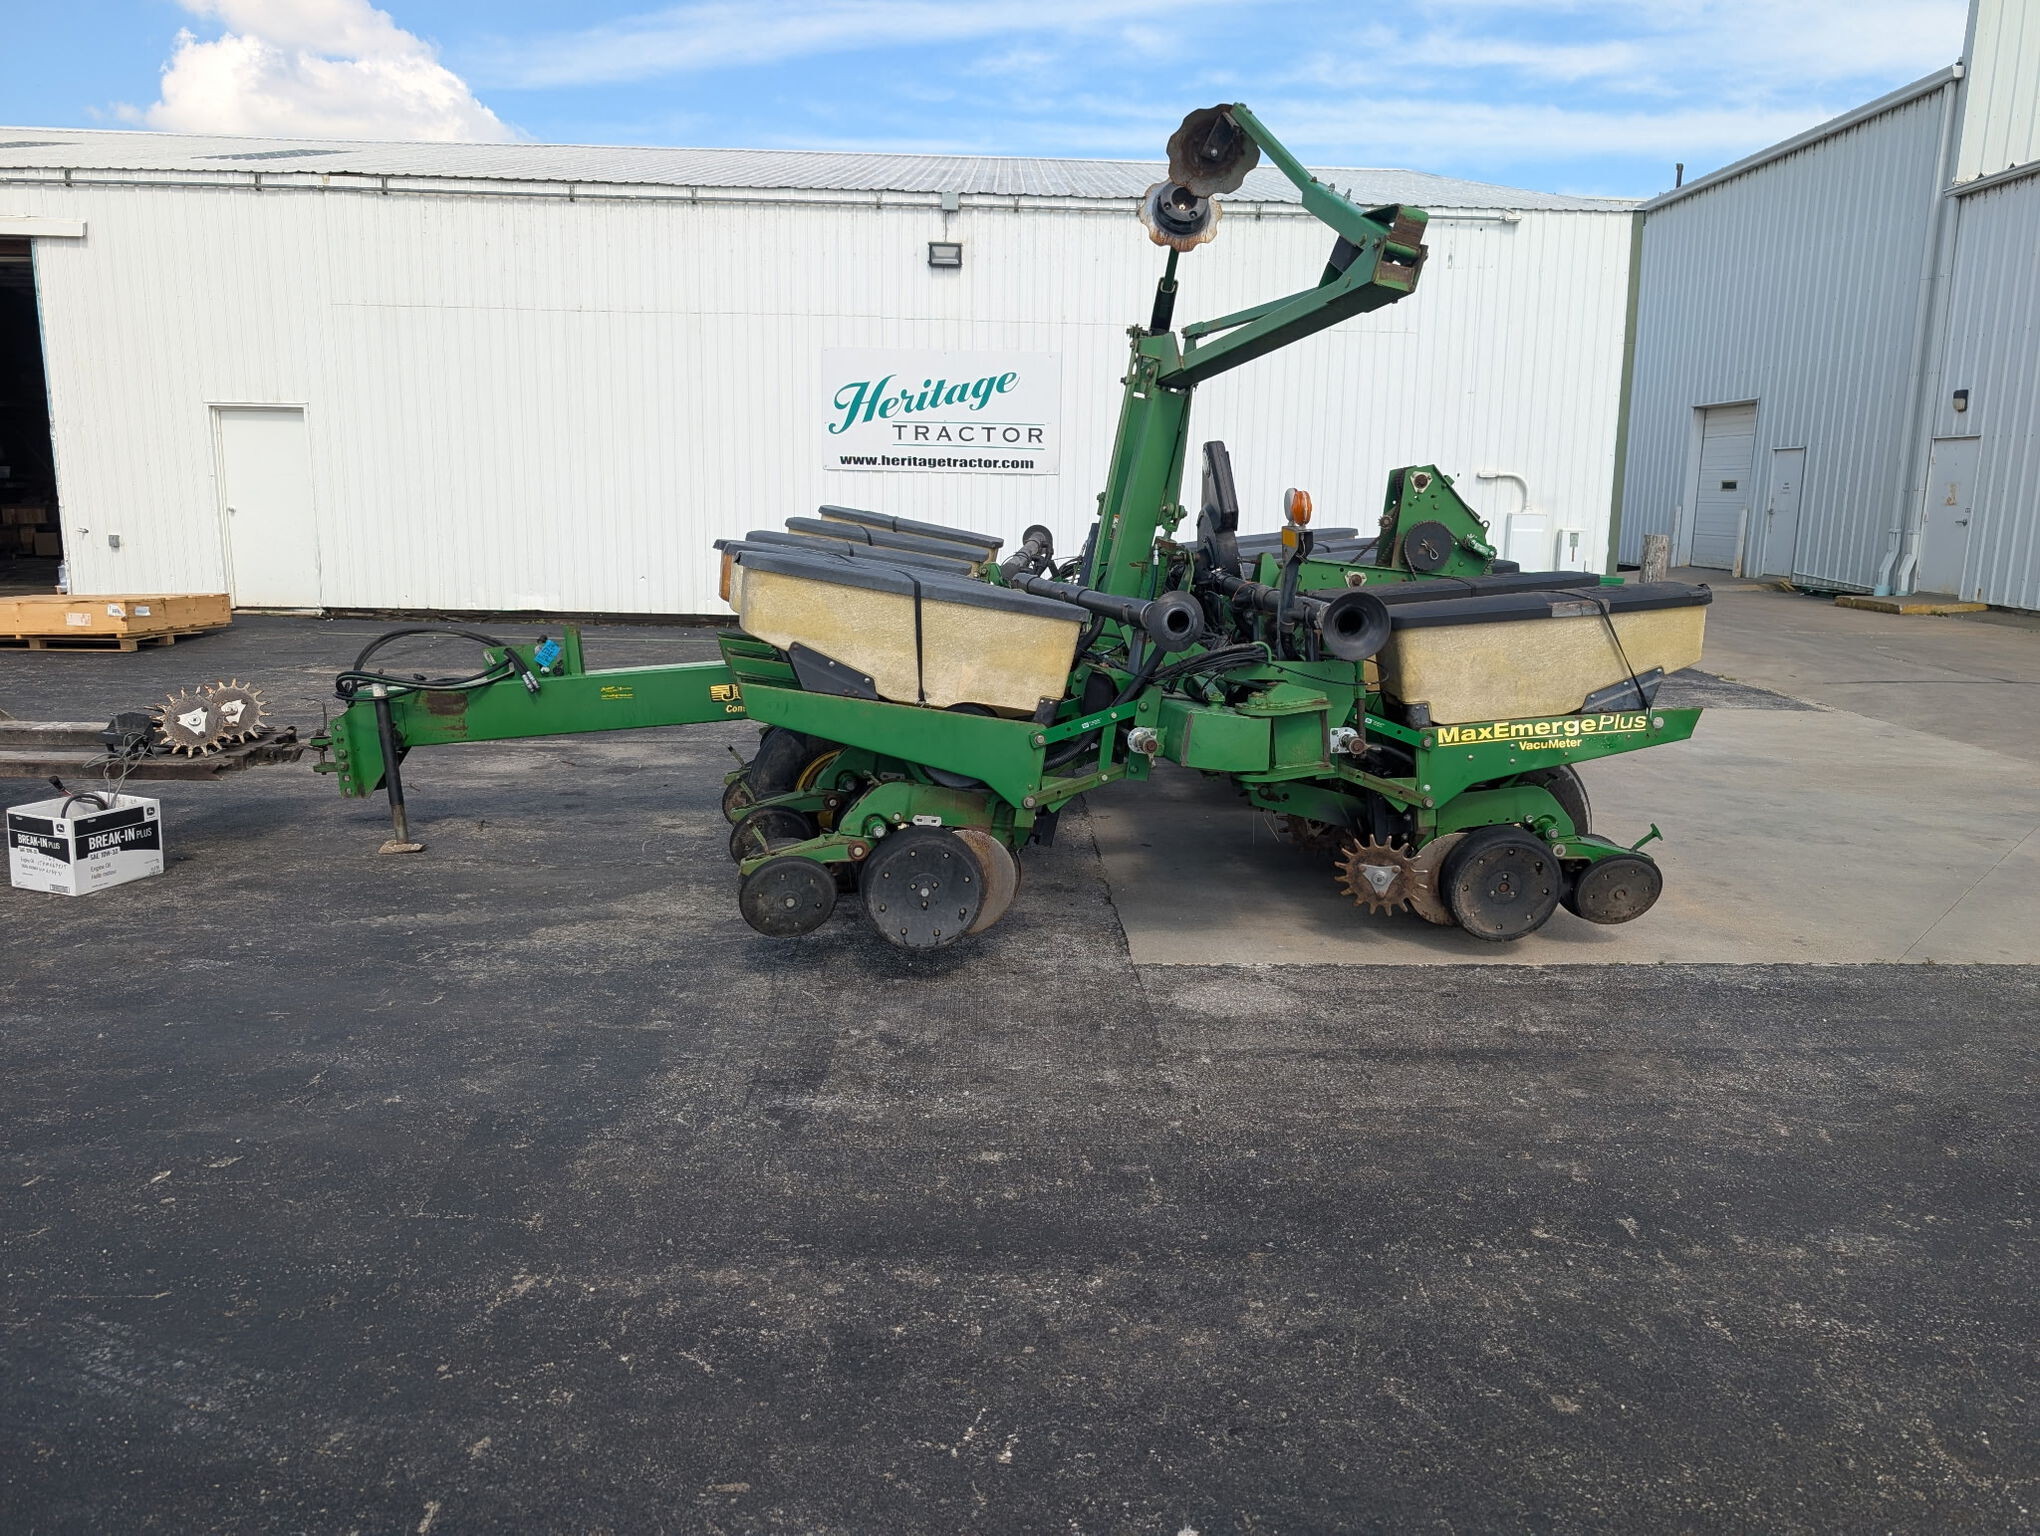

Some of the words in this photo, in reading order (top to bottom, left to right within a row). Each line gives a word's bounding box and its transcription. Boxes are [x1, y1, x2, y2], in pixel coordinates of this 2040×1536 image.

[828, 371, 1021, 435] Heritage
[892, 424, 1044, 444] TRACTOR
[839, 455, 1035, 469] www.heritagetractor.com
[1519, 738, 1583, 751] VacuMeter
[17, 833, 48, 849] BREAK-IN
[48, 842, 61, 850] PLUS
[88, 828, 136, 851] BREAK-IN
[136, 827, 153, 840] PLUS
